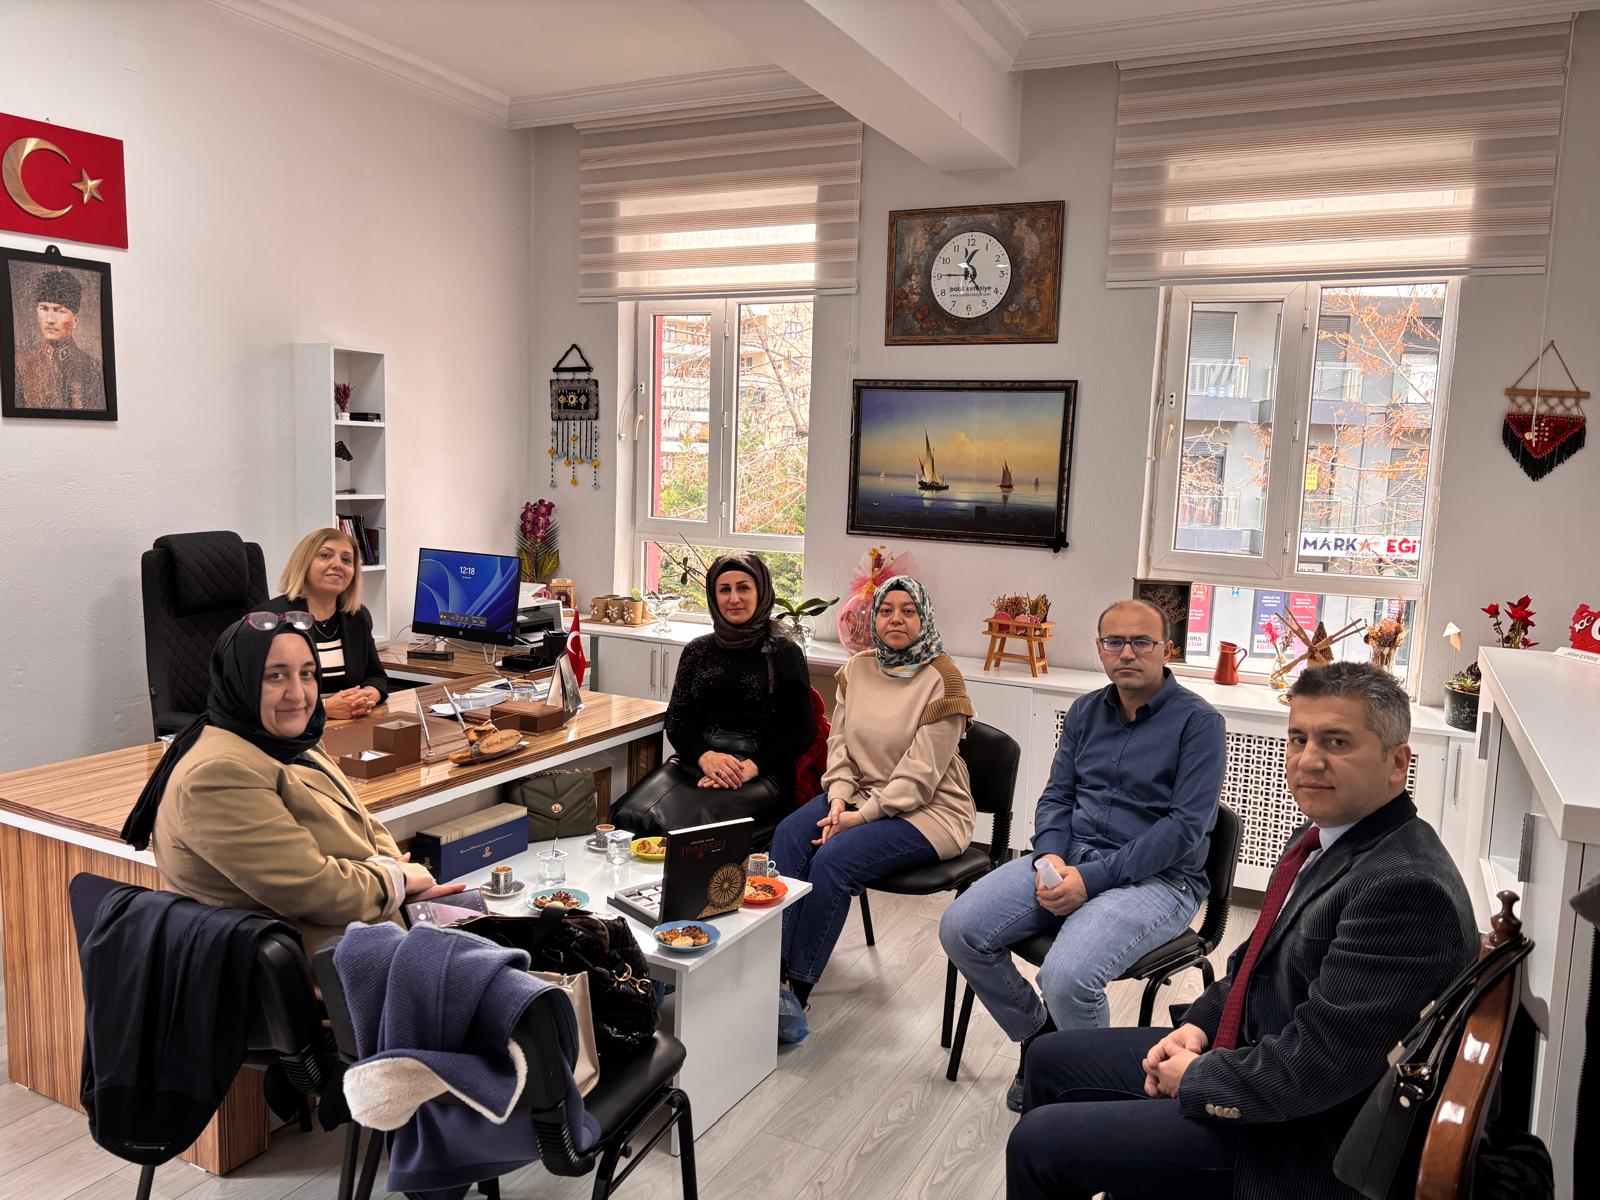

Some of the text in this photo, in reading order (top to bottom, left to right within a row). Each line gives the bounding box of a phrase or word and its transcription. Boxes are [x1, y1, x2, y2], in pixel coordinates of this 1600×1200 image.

[967, 238, 976, 247] 12
[953, 244, 960, 252] 11
[985, 243, 989, 251] 1
[942, 257, 951, 265] 10
[995, 254, 1001, 263] 2
[998, 270, 1005, 278] 3
[993, 287, 999, 295] 4
[951, 300, 957, 308] 7
[965, 304, 972, 312] 6
[1386, 538, 1421, 553] EĞİ
[460, 566, 475, 575] 12:18
